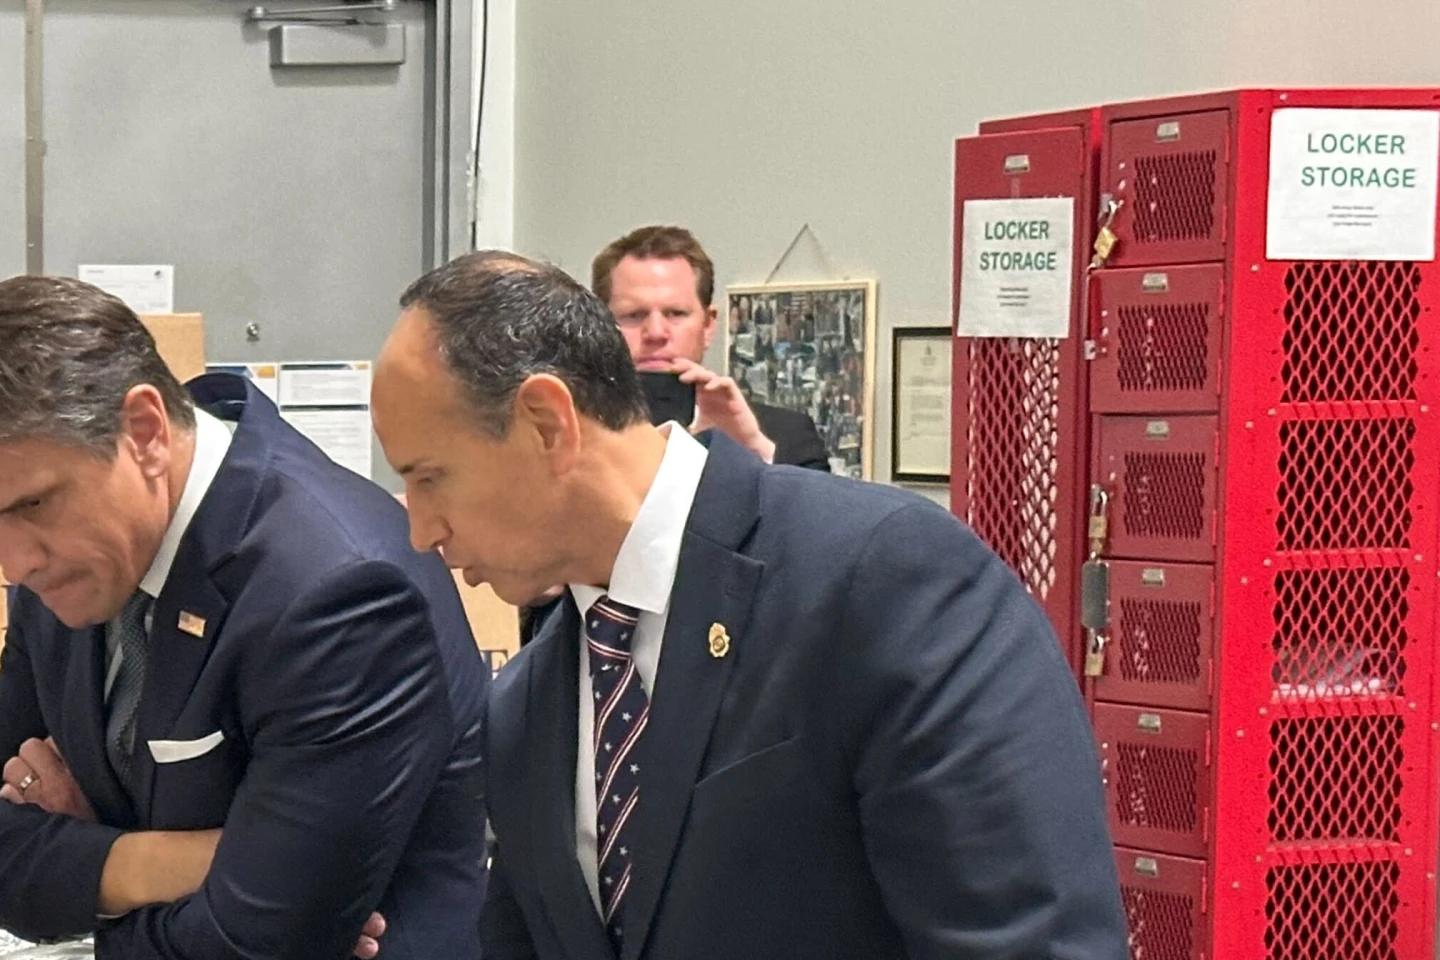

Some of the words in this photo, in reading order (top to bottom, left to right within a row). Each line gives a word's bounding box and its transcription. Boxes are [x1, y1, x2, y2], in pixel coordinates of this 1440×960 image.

[1306, 133, 1405, 155] LOCKER
[1301, 166, 1417, 188] STORAGE
[984, 220, 1049, 240] LOCKER
[980, 251, 1057, 271] STORAGE
